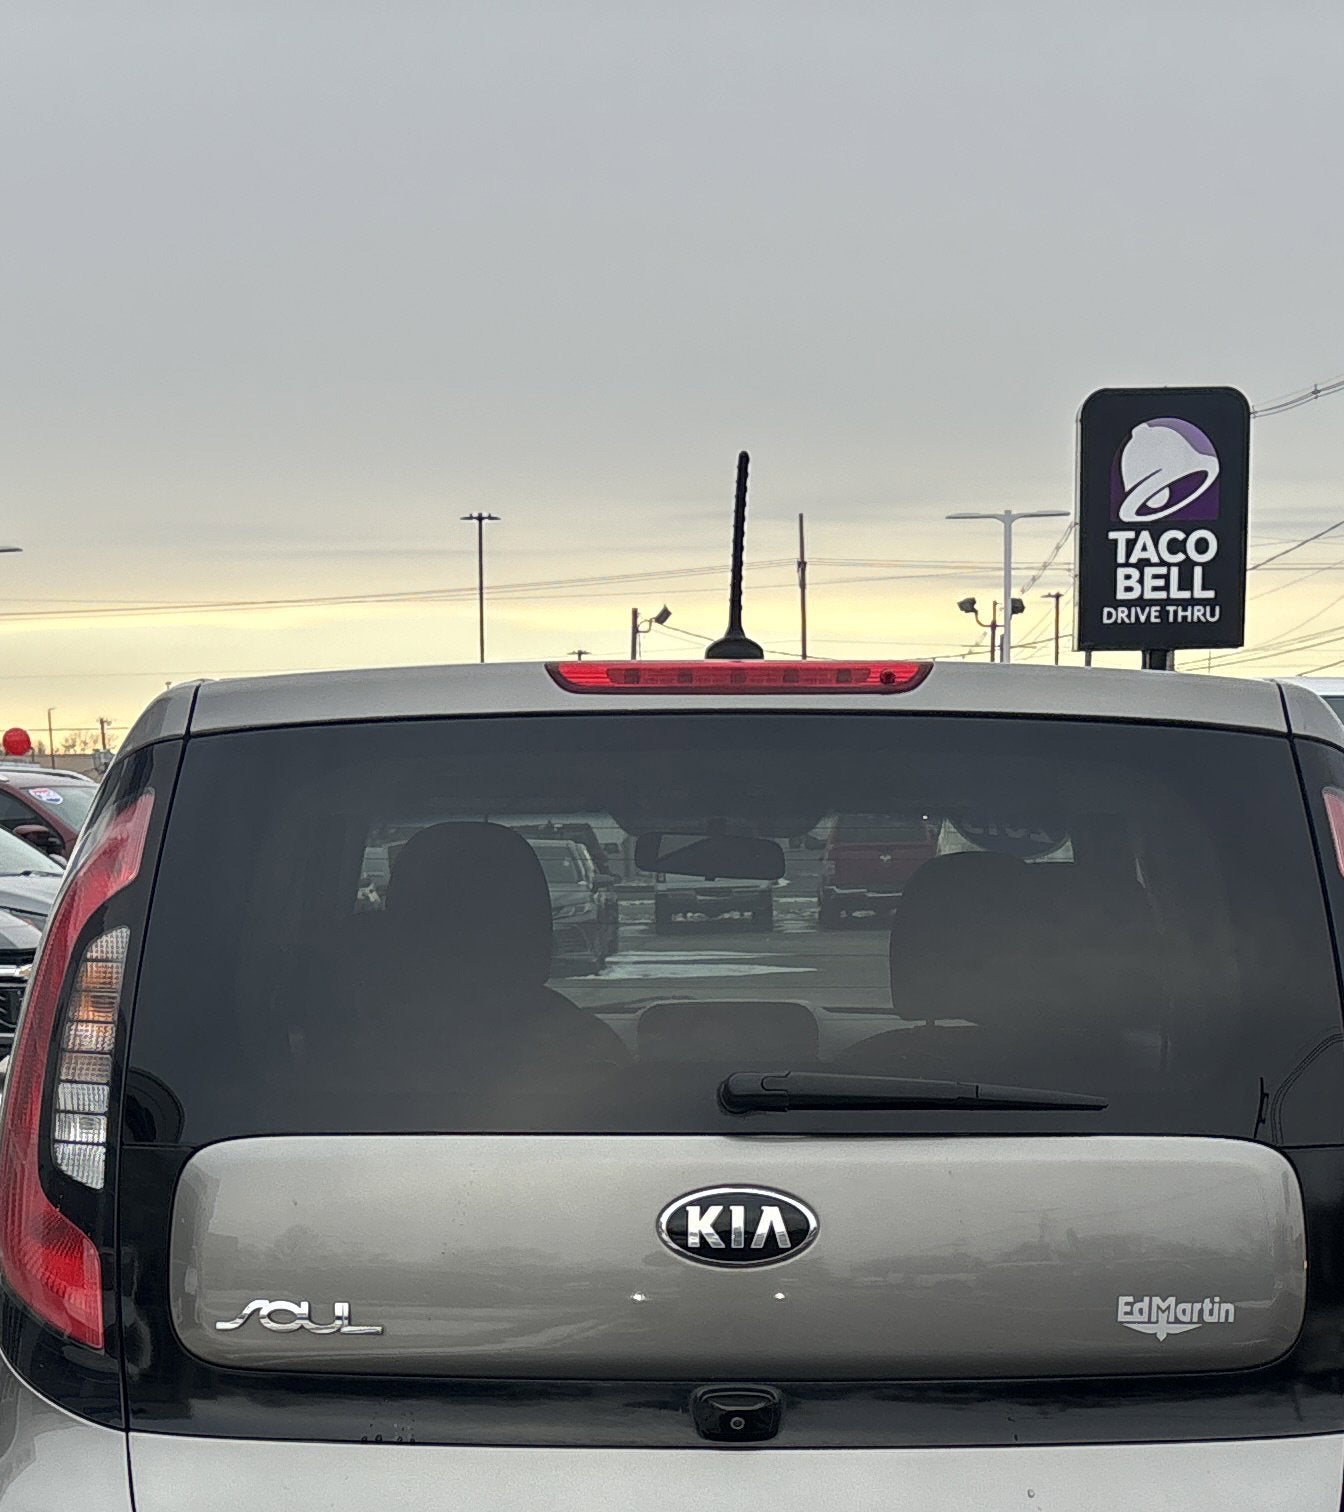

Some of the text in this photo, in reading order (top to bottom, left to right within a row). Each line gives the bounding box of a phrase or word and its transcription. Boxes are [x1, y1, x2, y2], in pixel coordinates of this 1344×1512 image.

[1107, 529, 1218, 563] TACO
[1115, 566, 1215, 600] BELL
[1102, 605, 1220, 624] DRIVE THRU
[686, 1205, 792, 1248] KIA
[216, 1299, 384, 1335] SOUL
[1117, 1296, 1235, 1324] EdMartin
